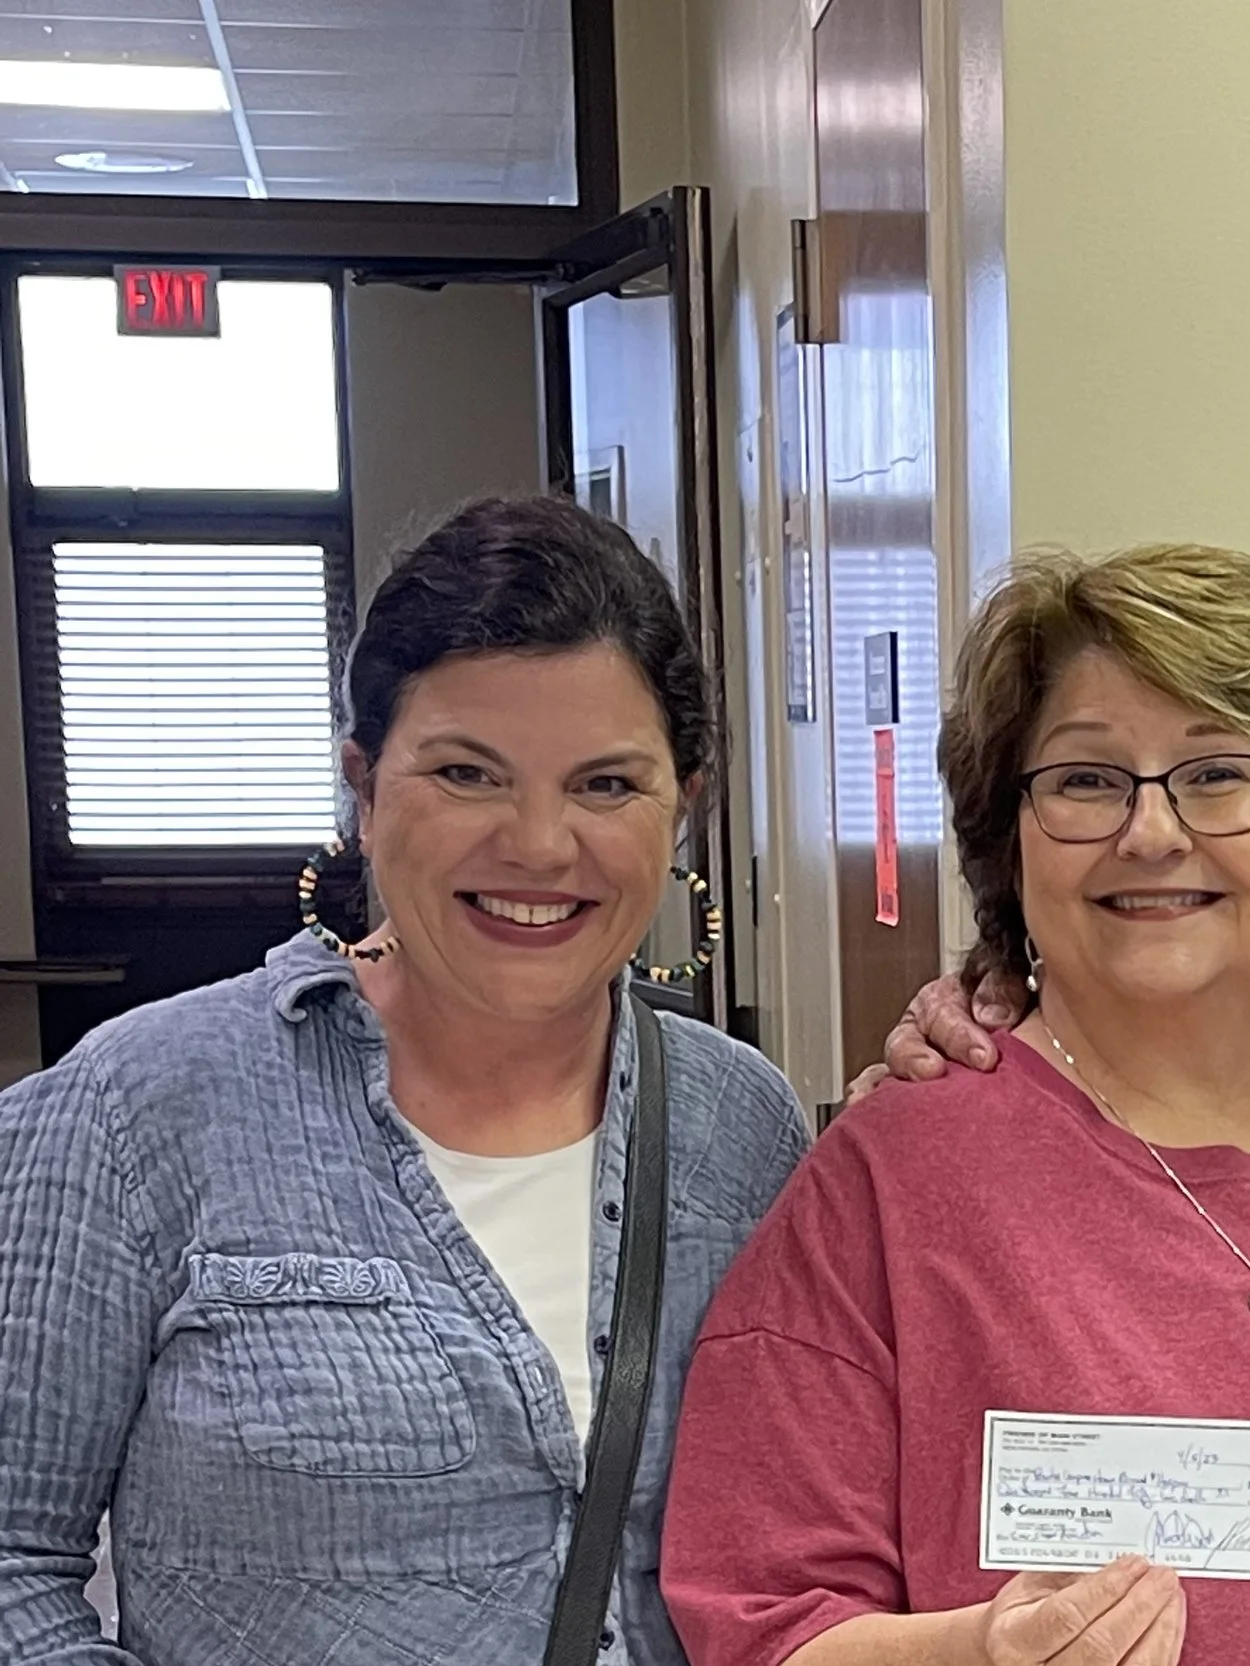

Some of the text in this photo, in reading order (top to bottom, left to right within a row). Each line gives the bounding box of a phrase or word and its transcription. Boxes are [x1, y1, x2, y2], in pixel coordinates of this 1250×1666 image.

[125, 270, 208, 329] EXIT
[1018, 1504, 1112, 1519] Guaranty Bank
